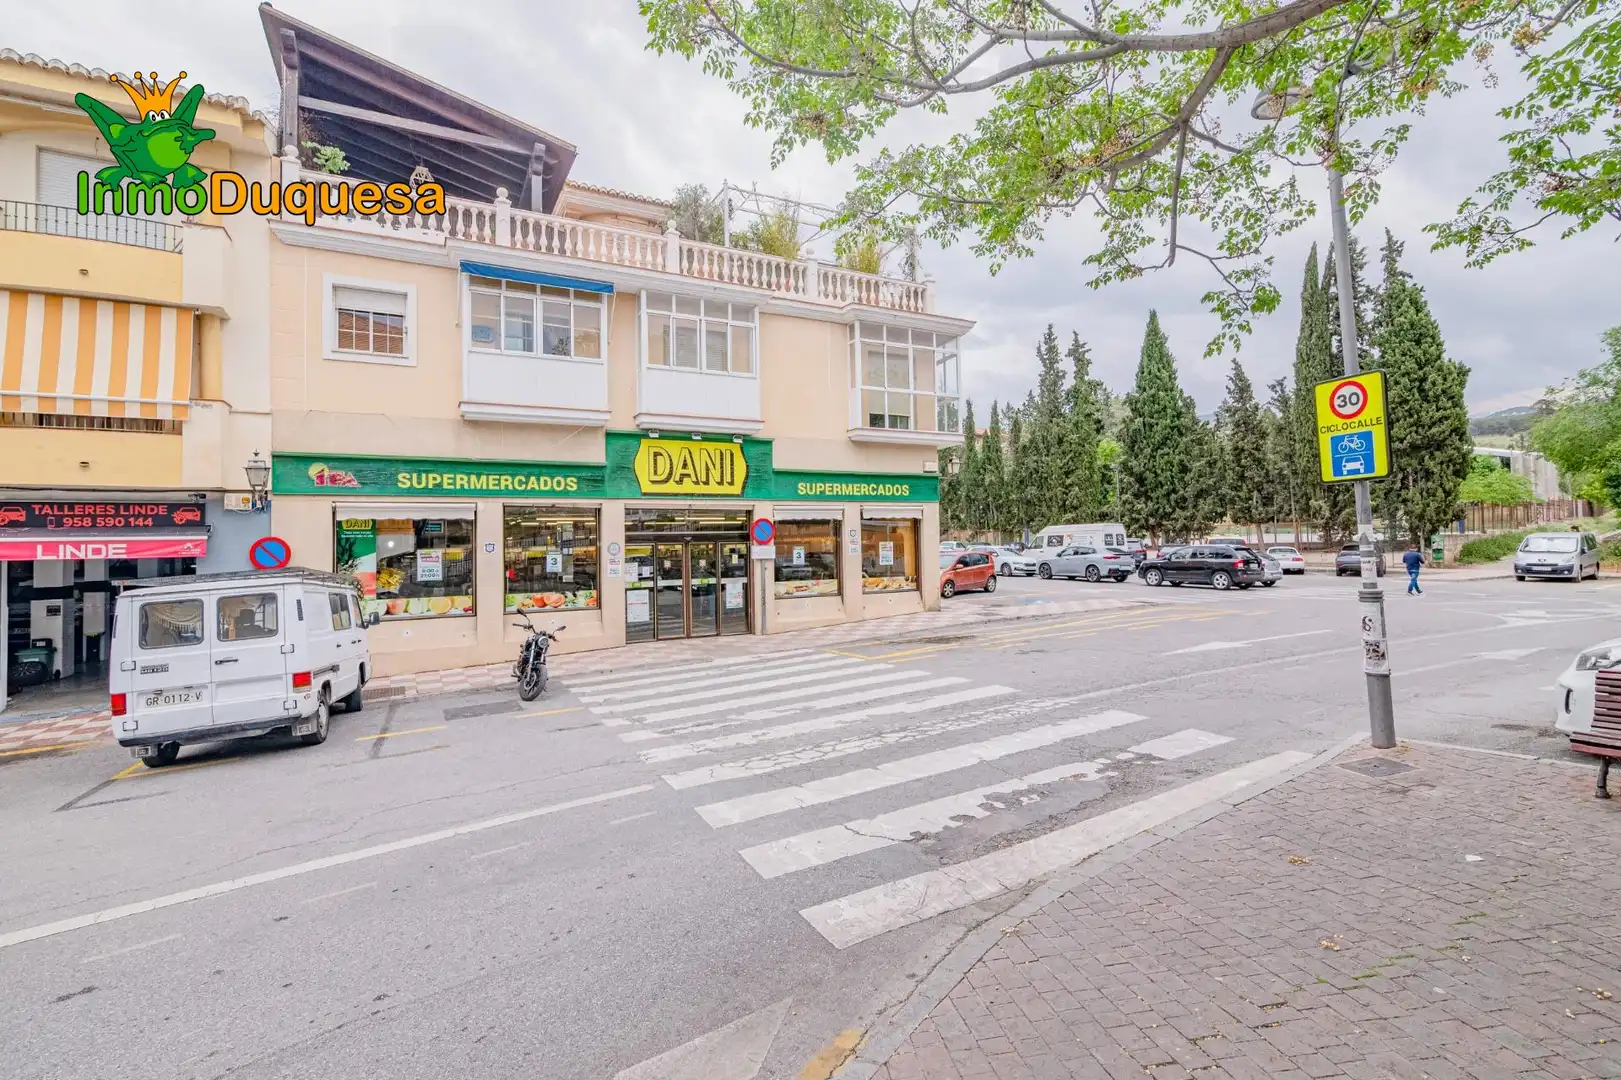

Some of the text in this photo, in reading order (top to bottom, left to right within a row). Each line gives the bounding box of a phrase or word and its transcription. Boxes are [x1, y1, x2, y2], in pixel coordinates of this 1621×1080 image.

[1336, 391, 1360, 408] 30
[1319, 416, 1384, 434] CICLOCALLE
[647, 445, 735, 487] DANI
[397, 472, 578, 492] SUPERMERCADOS
[797, 482, 910, 497] SUPERMERCADOS
[31, 504, 168, 515] TALLERES LINDE
[63, 517, 153, 527] 958 590 144
[345, 519, 371, 529] DANI
[36, 543, 128, 560] LINDE
[796, 551, 802, 559] 3
[551, 557, 558, 566] 3
